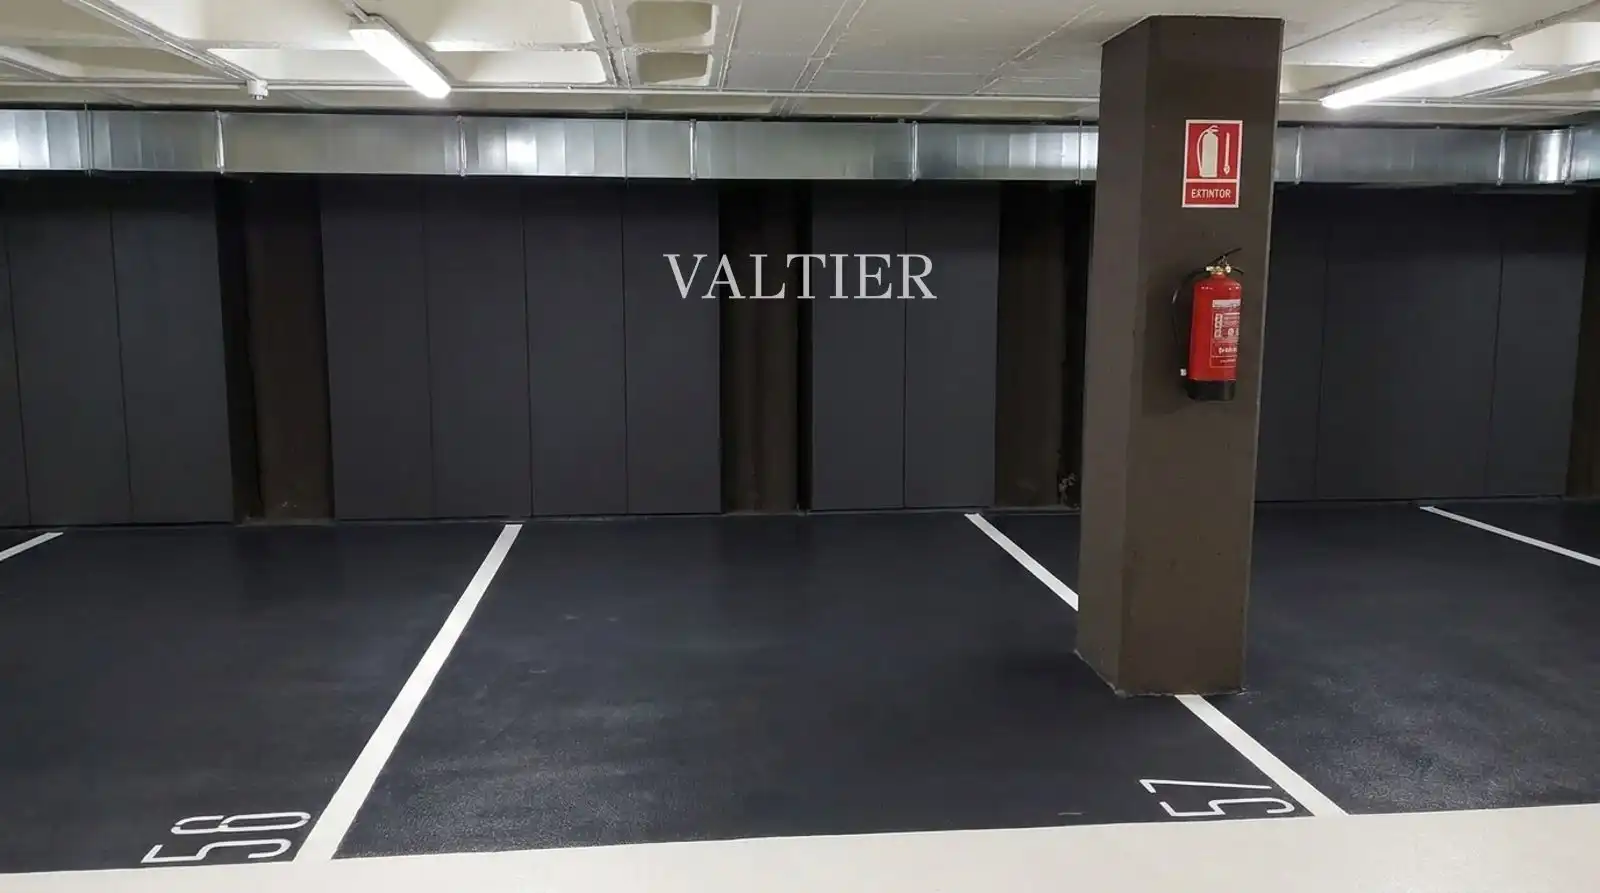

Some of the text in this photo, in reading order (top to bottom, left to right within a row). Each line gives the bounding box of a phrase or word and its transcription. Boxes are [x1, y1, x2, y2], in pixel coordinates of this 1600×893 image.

[1191, 188, 1232, 198] EXTINTOR
[1139, 779, 1295, 816] 57
[141, 811, 311, 863] 56
